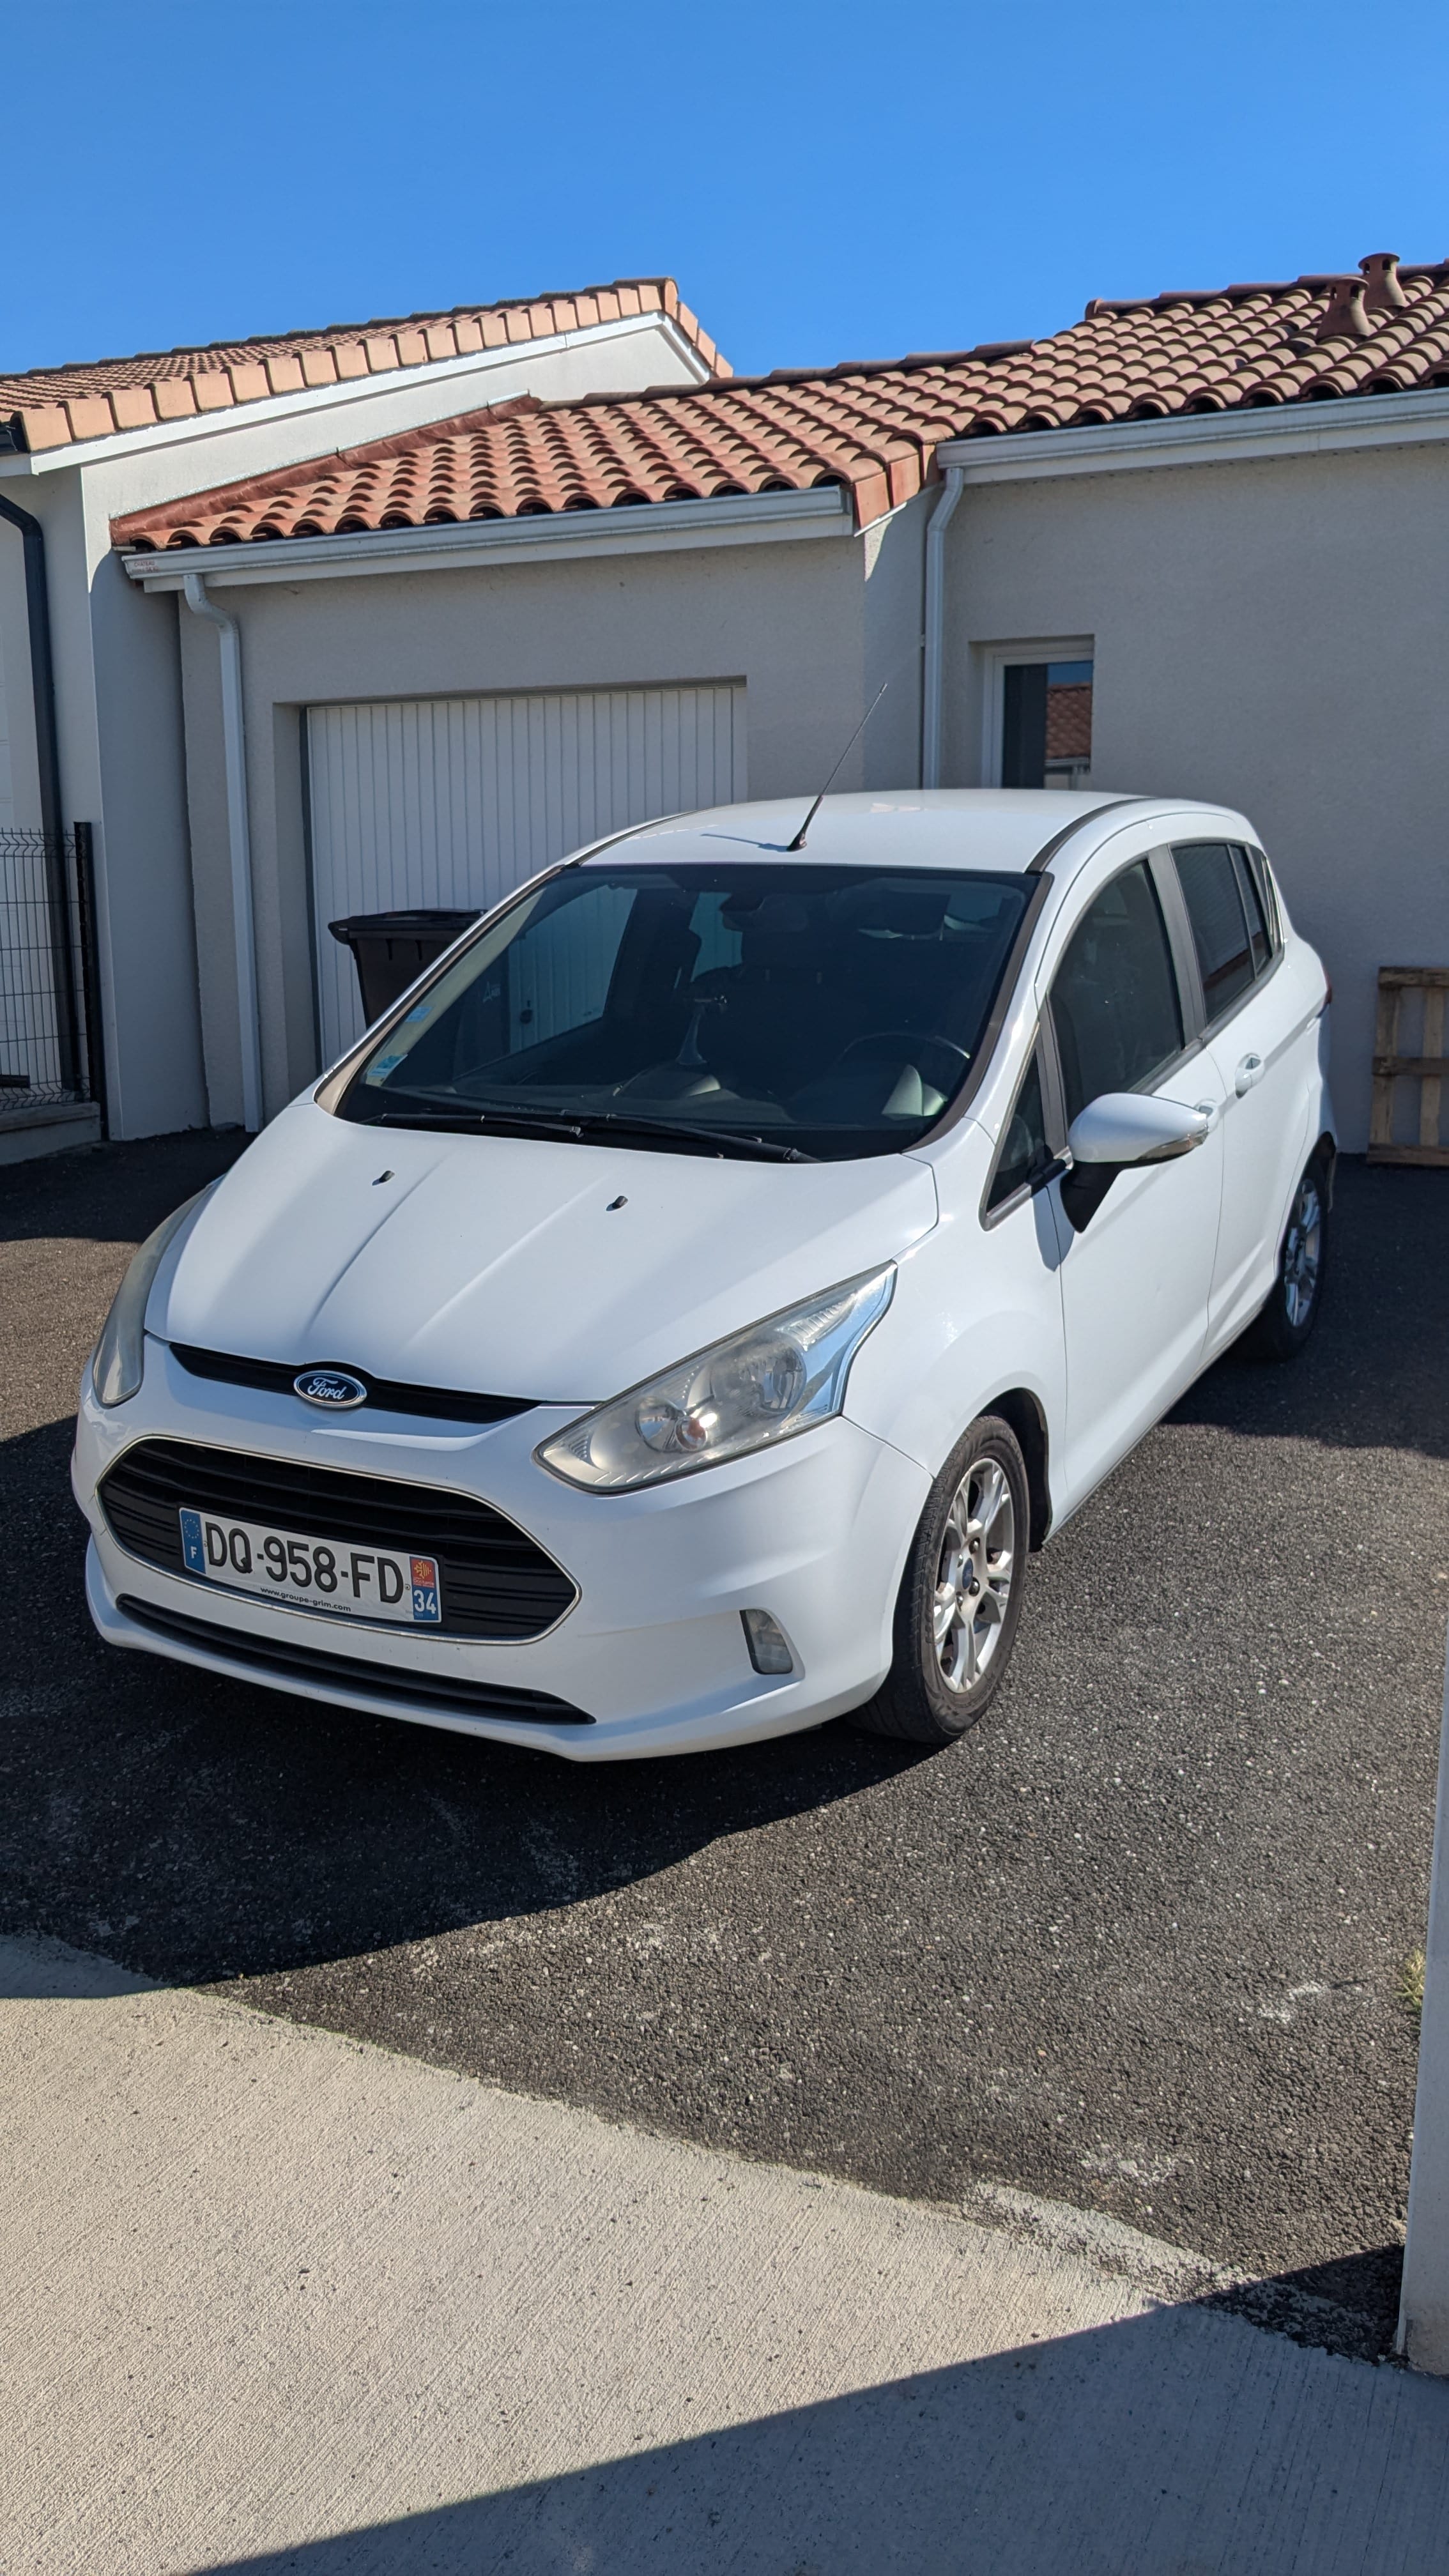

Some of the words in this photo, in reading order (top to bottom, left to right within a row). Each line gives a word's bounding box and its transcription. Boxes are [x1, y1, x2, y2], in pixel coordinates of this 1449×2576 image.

[307, 1377, 347, 1400] Ford
[190, 1546, 197, 1559] F
[205, 1522, 404, 1604] DQ-958-FD
[260, 1587, 351, 1612] www.groupe-grim.com
[413, 1590, 436, 1614] 34
